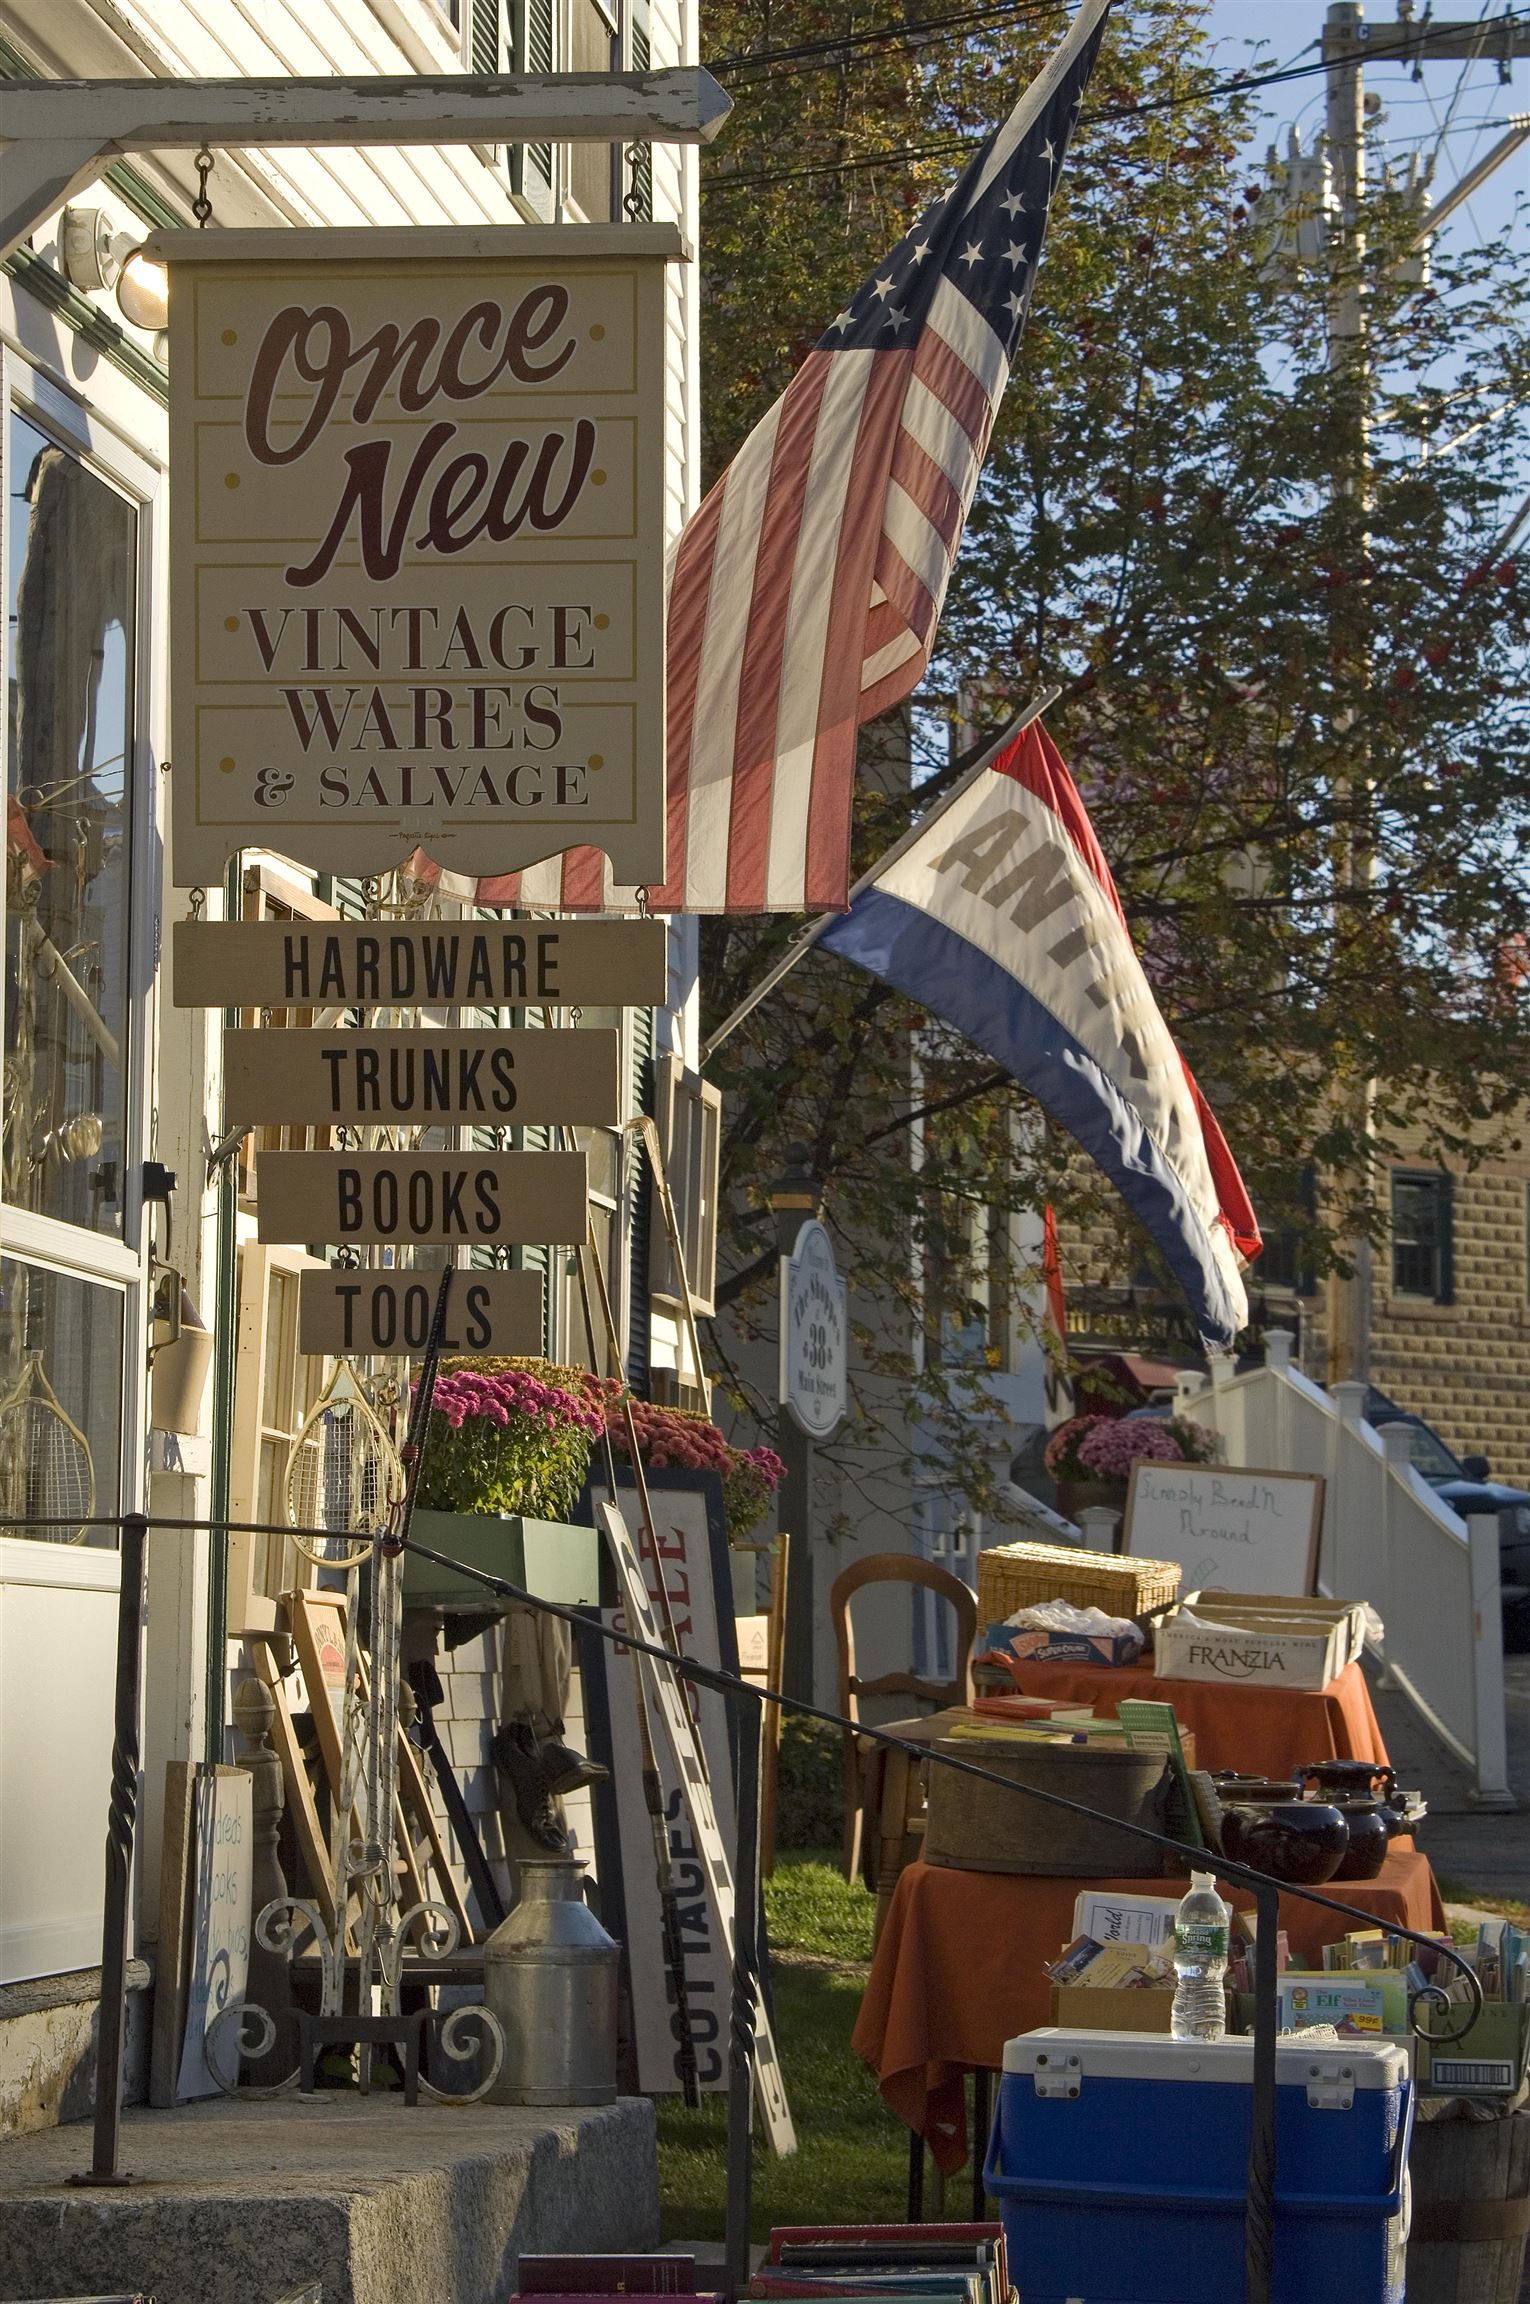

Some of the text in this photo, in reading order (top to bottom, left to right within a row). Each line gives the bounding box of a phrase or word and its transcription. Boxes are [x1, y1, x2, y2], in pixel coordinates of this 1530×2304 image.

[245, 284, 576, 465] Once
[284, 418, 596, 587] New
[242, 605, 595, 673] VINTAGE
[279, 685, 563, 752] WARES
[253, 765, 589, 808] & SALVAGE
[284, 934, 560, 999] HARDWARE
[321, 1047, 518, 1113] TRUNKS
[338, 1168, 501, 1235] BOOKS
[335, 1285, 493, 1350] TOOLS
[809, 1323, 826, 1370] 38
[1189, 1645, 1287, 1677] FRANZIA
[1182, 1934, 1213, 1946] Spring
[1316, 1994, 1341, 2007] Elf
